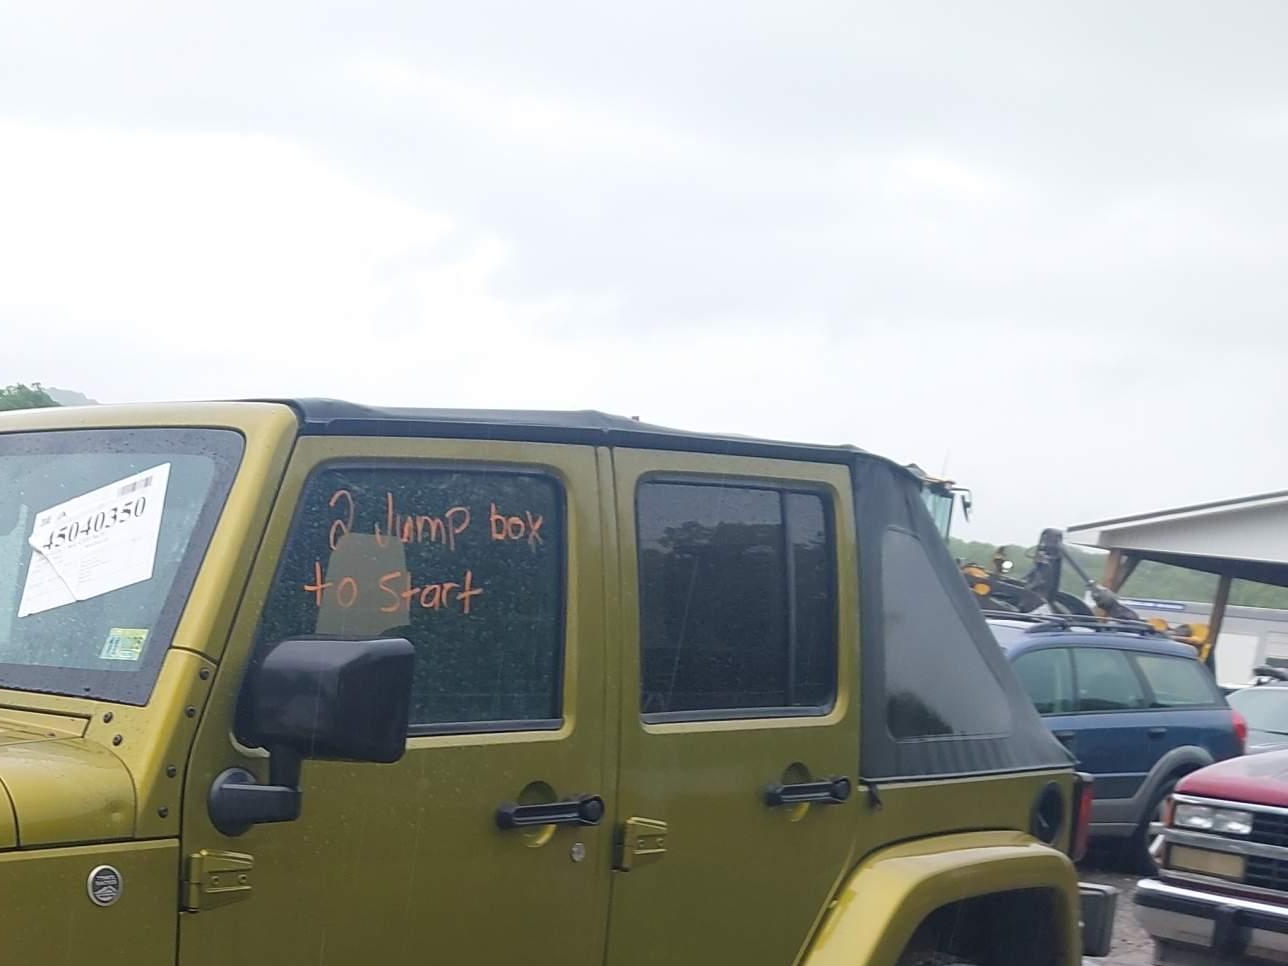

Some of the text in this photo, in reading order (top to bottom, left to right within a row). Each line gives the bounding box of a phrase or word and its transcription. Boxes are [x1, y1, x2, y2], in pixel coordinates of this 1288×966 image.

[42, 496, 146, 549] 45040350
[328, 489, 355, 550] 2
[490, 502, 543, 552] box
[304, 560, 358, 606] to
